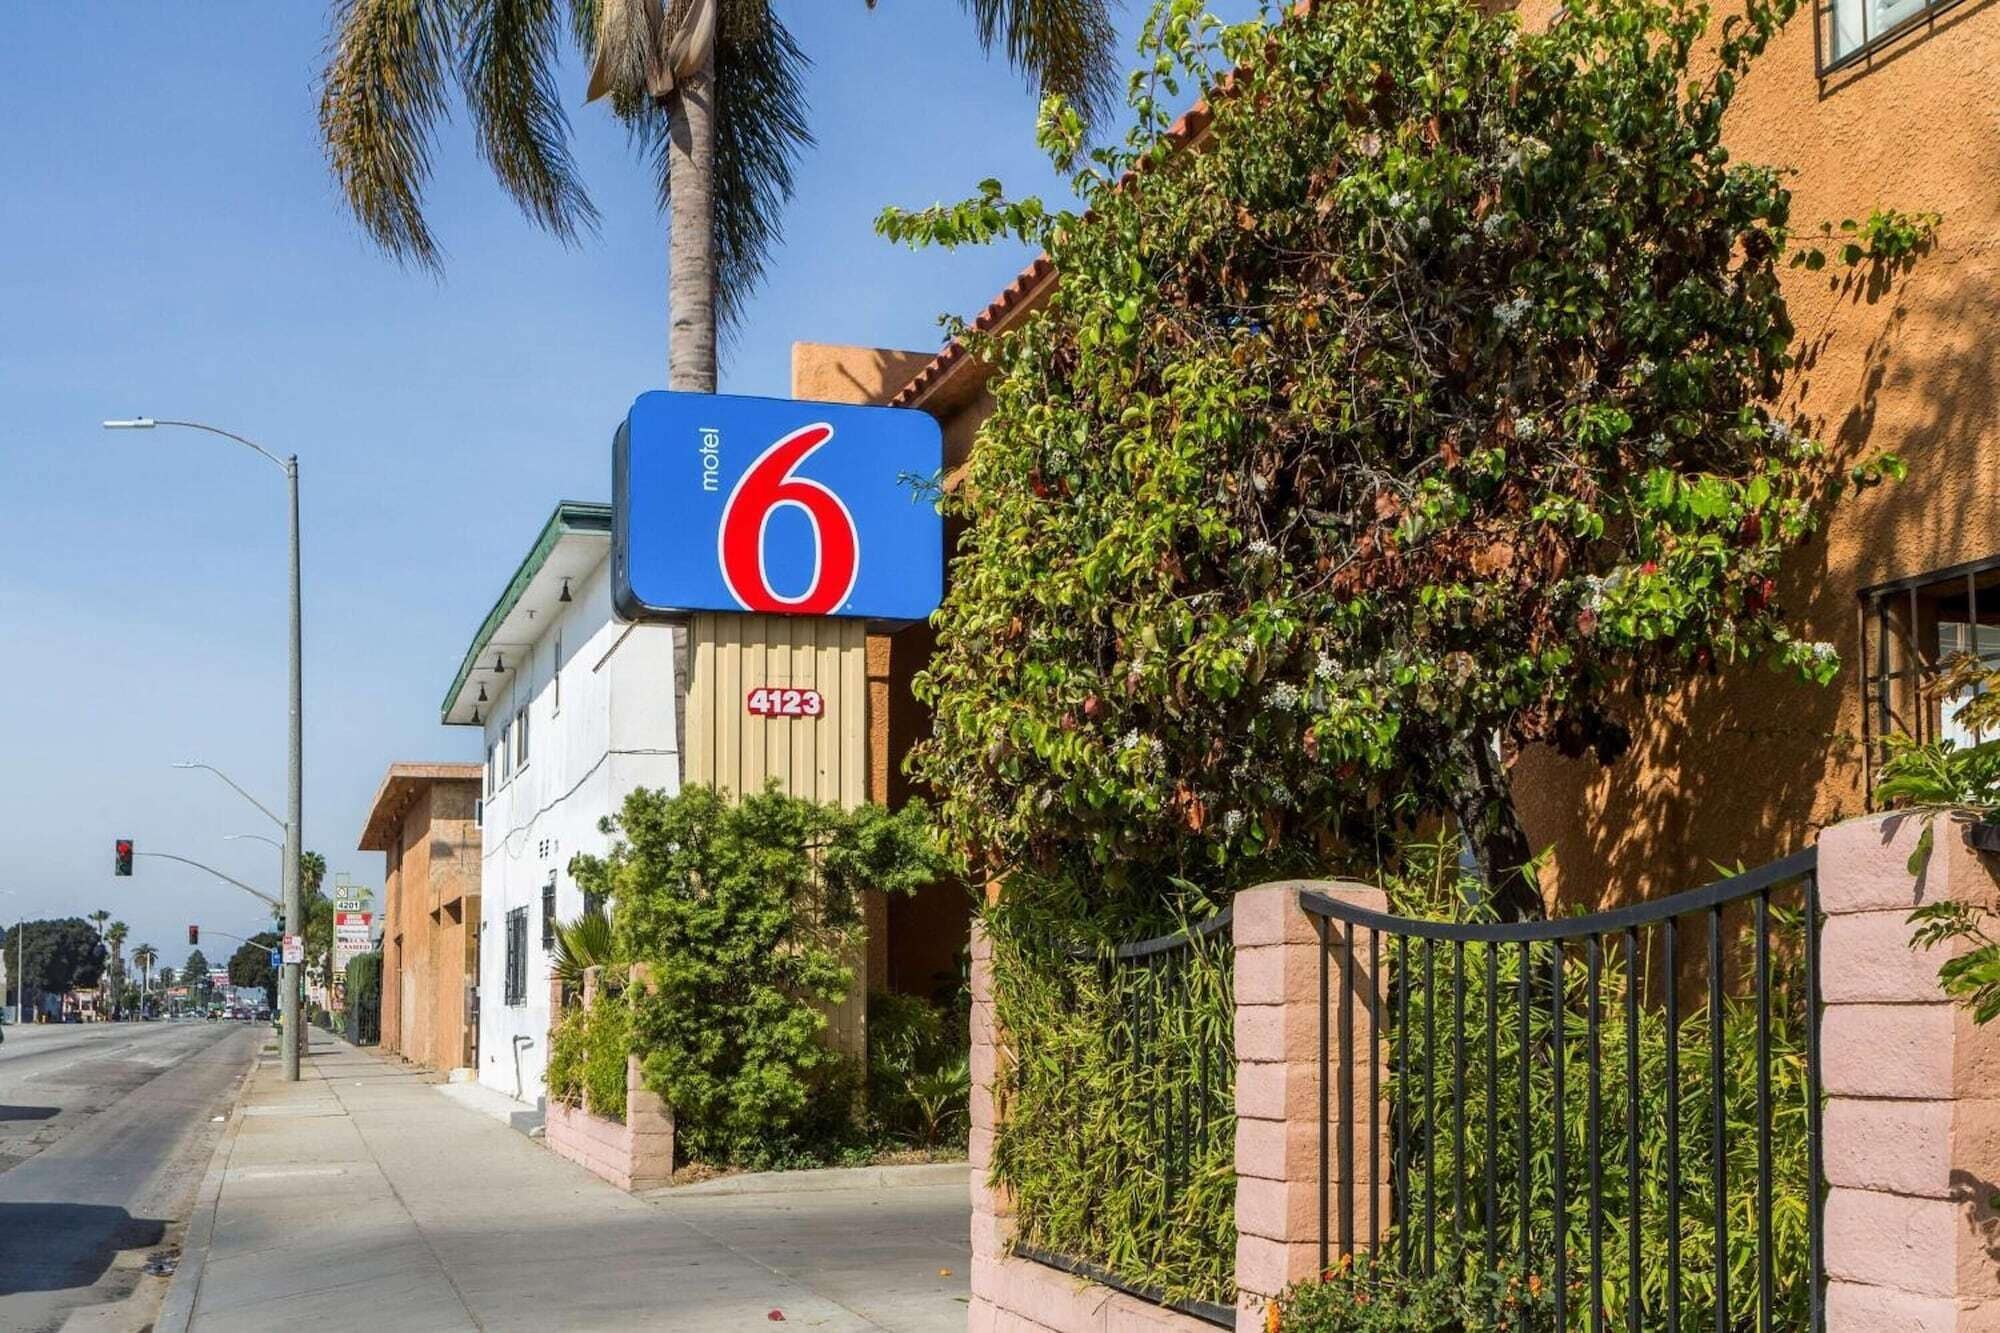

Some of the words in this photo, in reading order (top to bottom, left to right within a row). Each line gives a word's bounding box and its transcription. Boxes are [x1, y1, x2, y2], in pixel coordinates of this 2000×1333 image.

[699, 427, 720, 491] motel
[718, 422, 860, 615] 6
[749, 689, 821, 714] 4123
